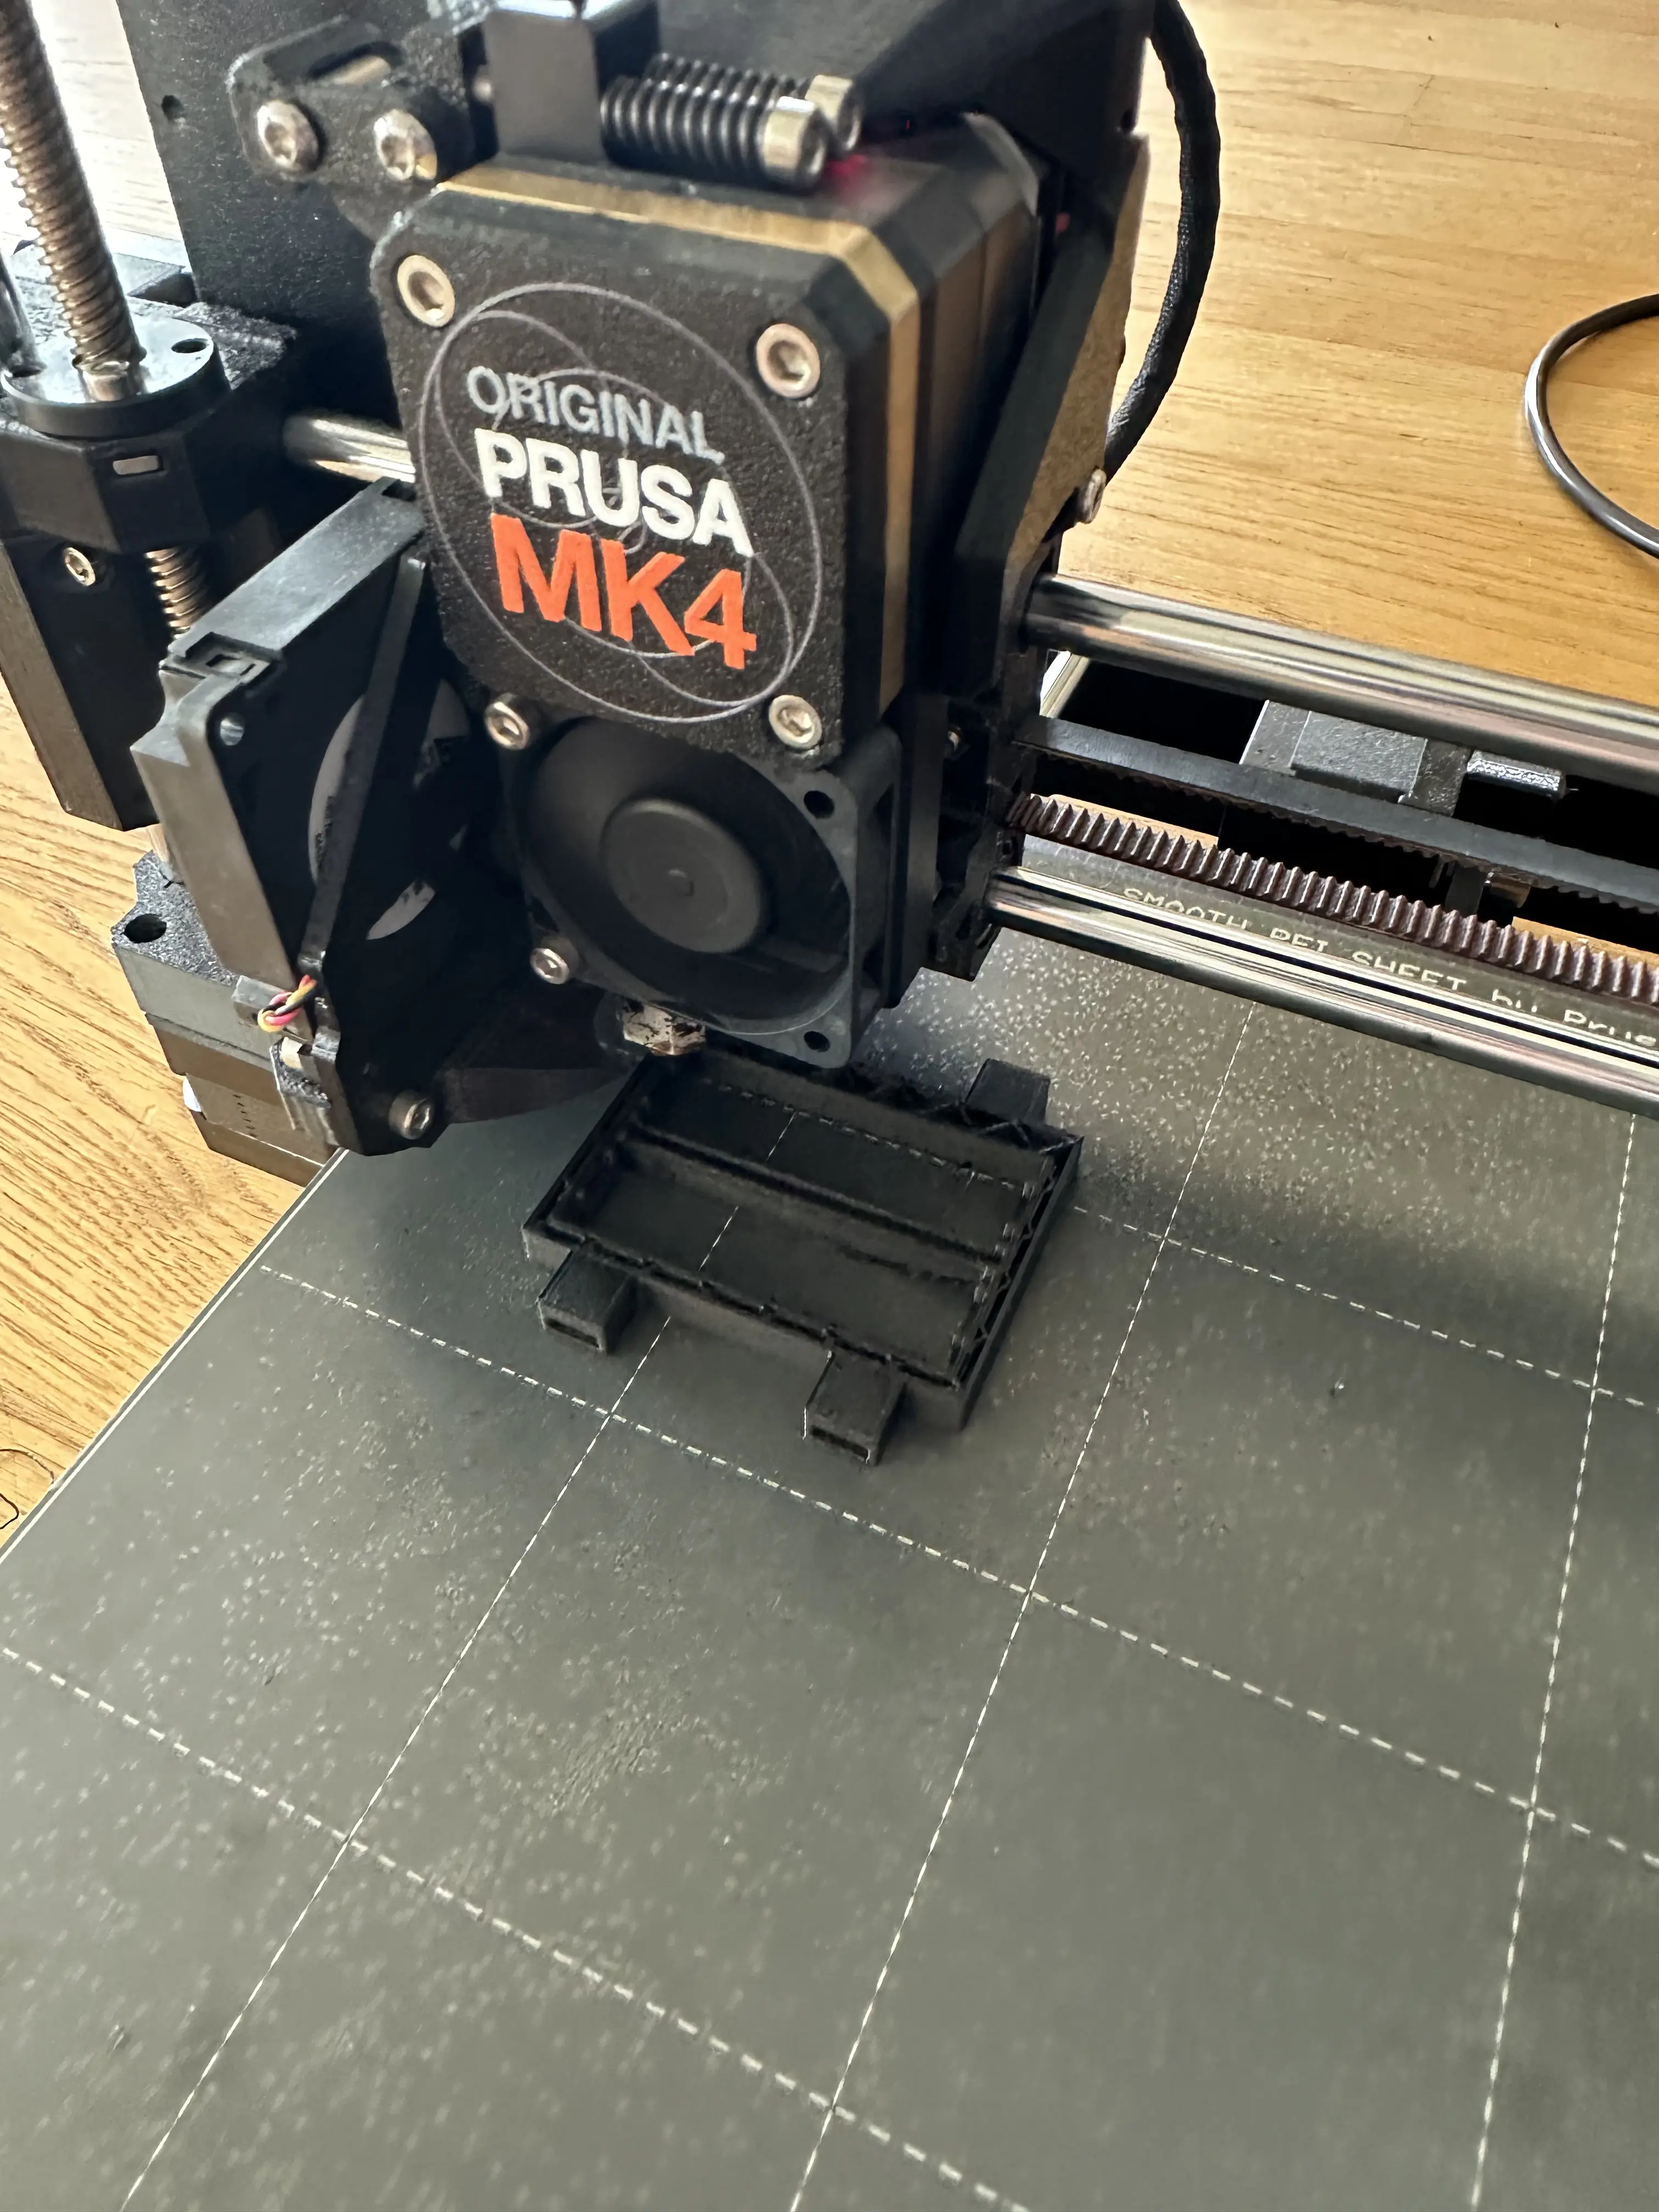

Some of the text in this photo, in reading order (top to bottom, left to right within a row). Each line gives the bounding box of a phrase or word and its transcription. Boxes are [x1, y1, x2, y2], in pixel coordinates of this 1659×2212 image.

[467, 366, 725, 465] ORIGINAL
[474, 428, 753, 557] PRUSA
[490, 512, 757, 670] MK4
